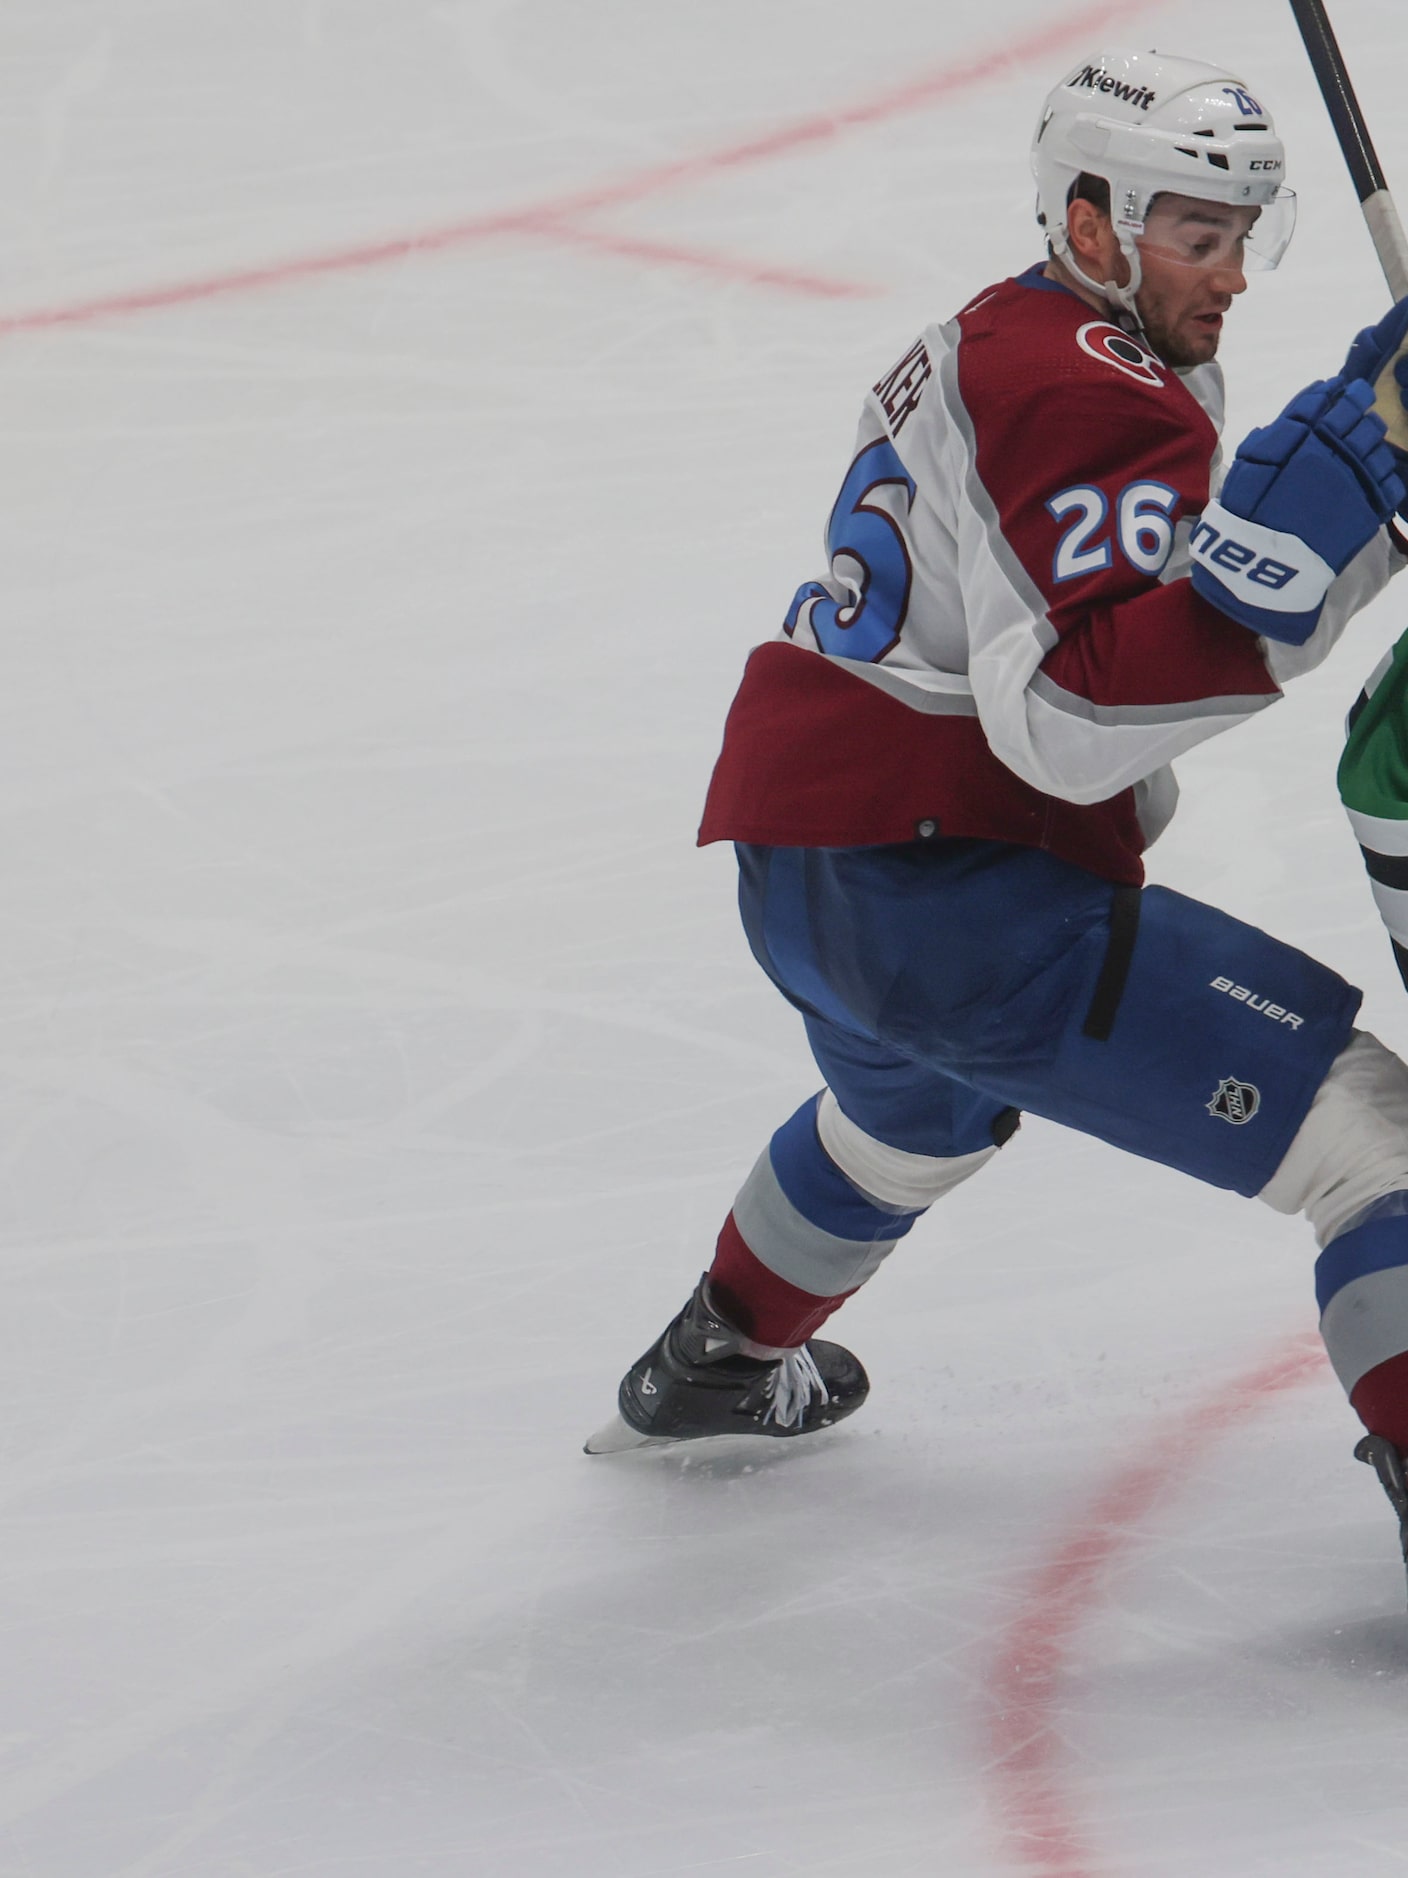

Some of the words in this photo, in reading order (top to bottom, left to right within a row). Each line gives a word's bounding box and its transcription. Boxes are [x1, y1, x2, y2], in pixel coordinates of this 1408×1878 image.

[1079, 65, 1155, 111] Kiewit
[1222, 88, 1262, 116] 26
[1249, 160, 1282, 171] CCM
[872, 338, 932, 439] KER
[1045, 479, 1180, 585] 26
[1228, 1087, 1243, 1117] NHL
